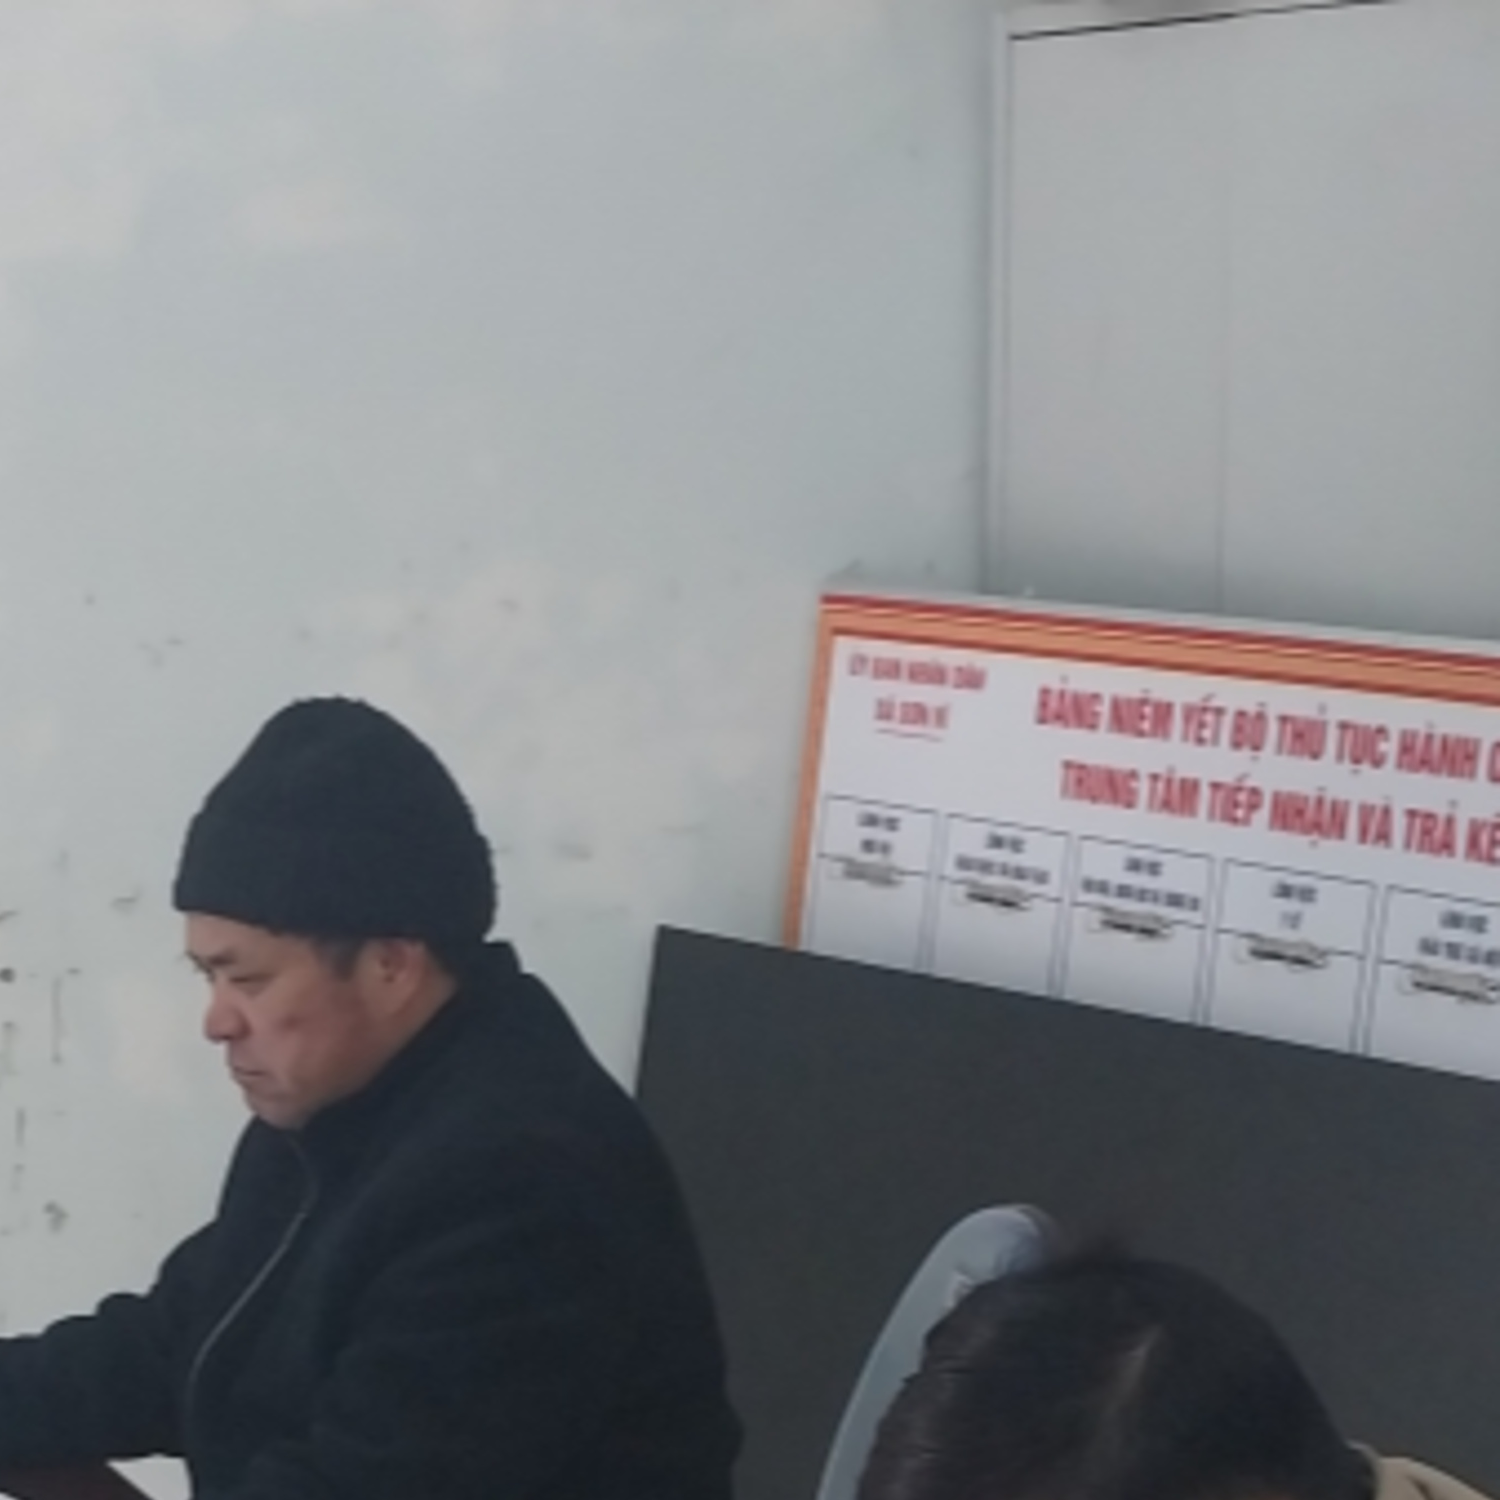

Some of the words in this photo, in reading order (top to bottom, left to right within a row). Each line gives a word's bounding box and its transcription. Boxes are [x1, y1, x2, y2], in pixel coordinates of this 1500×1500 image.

[1179, 693, 1228, 748] YẾT
[1229, 701, 1269, 762] BỘ
[1274, 702, 1329, 762] THỦ
[1335, 719, 1391, 776] TỤC
[1395, 720, 1483, 781] HÀNH
[1059, 759, 1140, 811] TRUNG
[1146, 764, 1201, 819] TÂM
[1206, 772, 1265, 828] TIẾP
[1267, 786, 1352, 849] NHẬN
[1357, 795, 1393, 850] VÀ
[1401, 800, 1457, 860] TRẢ
